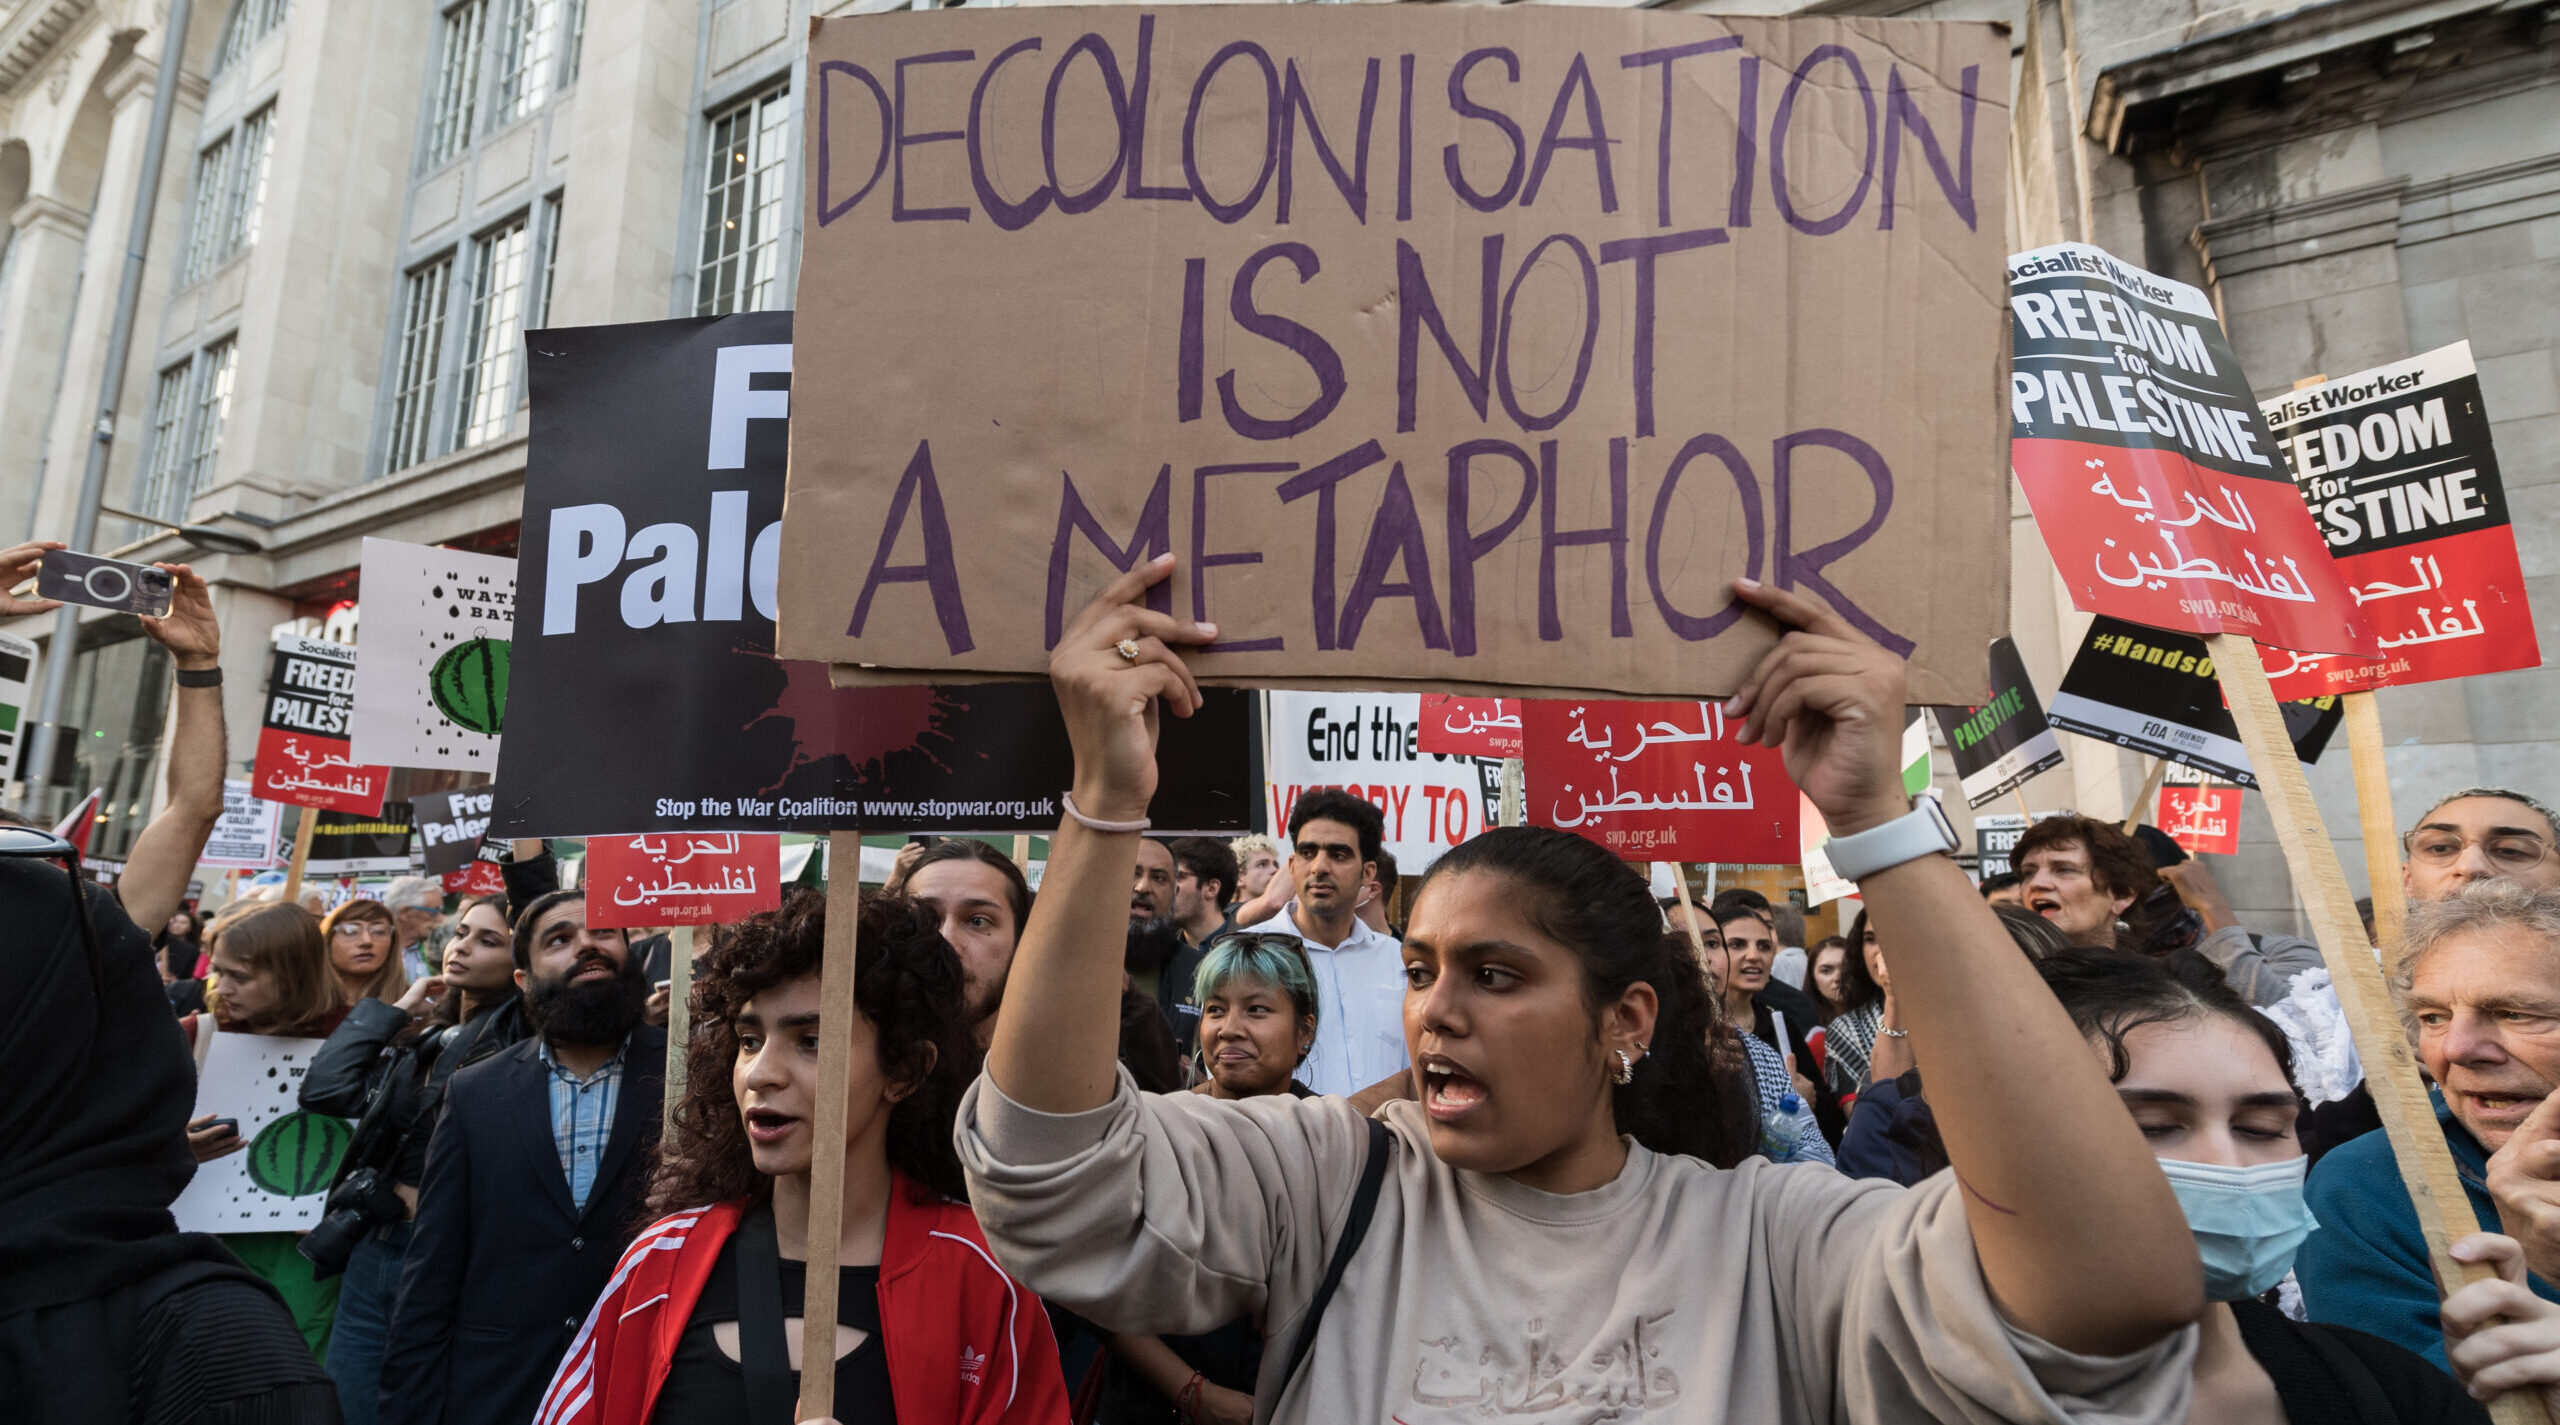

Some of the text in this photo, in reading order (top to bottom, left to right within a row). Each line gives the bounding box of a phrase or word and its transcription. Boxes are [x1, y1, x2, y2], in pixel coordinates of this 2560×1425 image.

[819, 13, 1979, 236] DECOLONISATION
[2102, 257, 2175, 305] Worker
[1178, 229, 1730, 440] IS NOT
[2114, 344, 2153, 377] for
[2322, 367, 2425, 409] Worker
[2011, 370, 2272, 468] PALESTINE
[2086, 457, 2257, 533] الحرية
[2310, 474, 2350, 501] for
[846, 429, 1917, 660] A METAPHOR
[2095, 529, 2316, 603] لفلسطين
[299, 640, 352, 660] Socialist
[2326, 657, 2411, 684] swp.org.uk
[327, 691, 348, 707] for
[1307, 705, 1418, 762] End the
[1567, 702, 1724, 762] الحرية
[1953, 686, 2025, 751] PALESTINE
[2141, 720, 2169, 740] FOA
[2174, 729, 2208, 745] FRIENDS
[267, 767, 371, 797] لفلسطين
[1553, 760, 1754, 827] لفلسطين
[655, 797, 1055, 820] Stop the War Coalition www.stopwar.org.uk
[1423, 785, 1468, 847] TO
[2170, 792, 2222, 816] الحرية
[1606, 825, 1677, 848] swp.org.uk
[613, 865, 757, 906] لفلسطين
[1695, 861, 1744, 873] opning
[661, 902, 713, 918] swp.org.uk
[961, 1371, 980, 1386] didas
